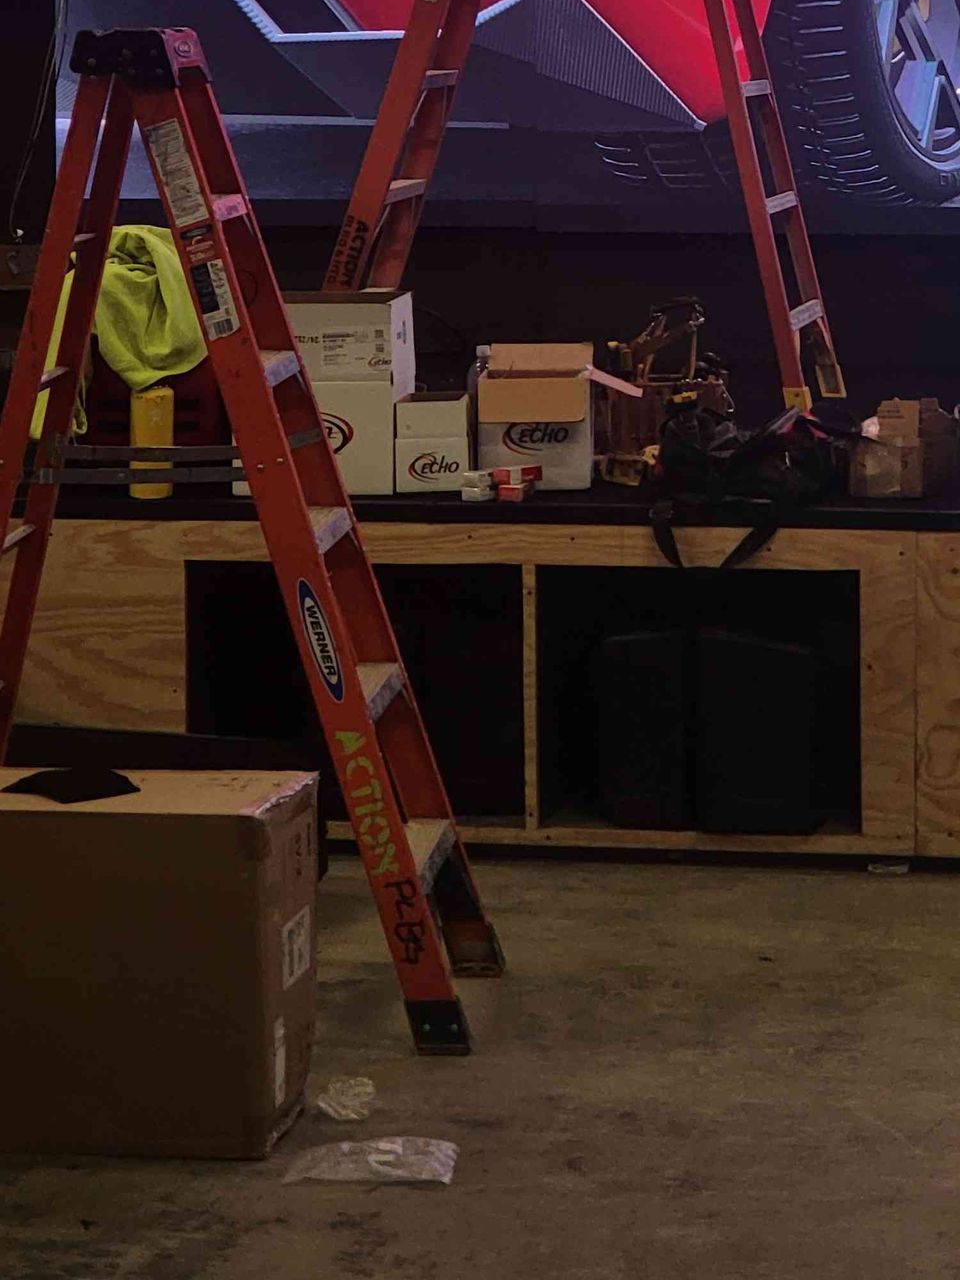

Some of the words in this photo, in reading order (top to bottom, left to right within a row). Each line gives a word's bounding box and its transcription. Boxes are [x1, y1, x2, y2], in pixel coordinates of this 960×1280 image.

[518, 422, 569, 443] ECHO
[420, 455, 459, 474] ECHO
[305, 605, 337, 676] WERNER
[334, 729, 398, 875] ACTION
